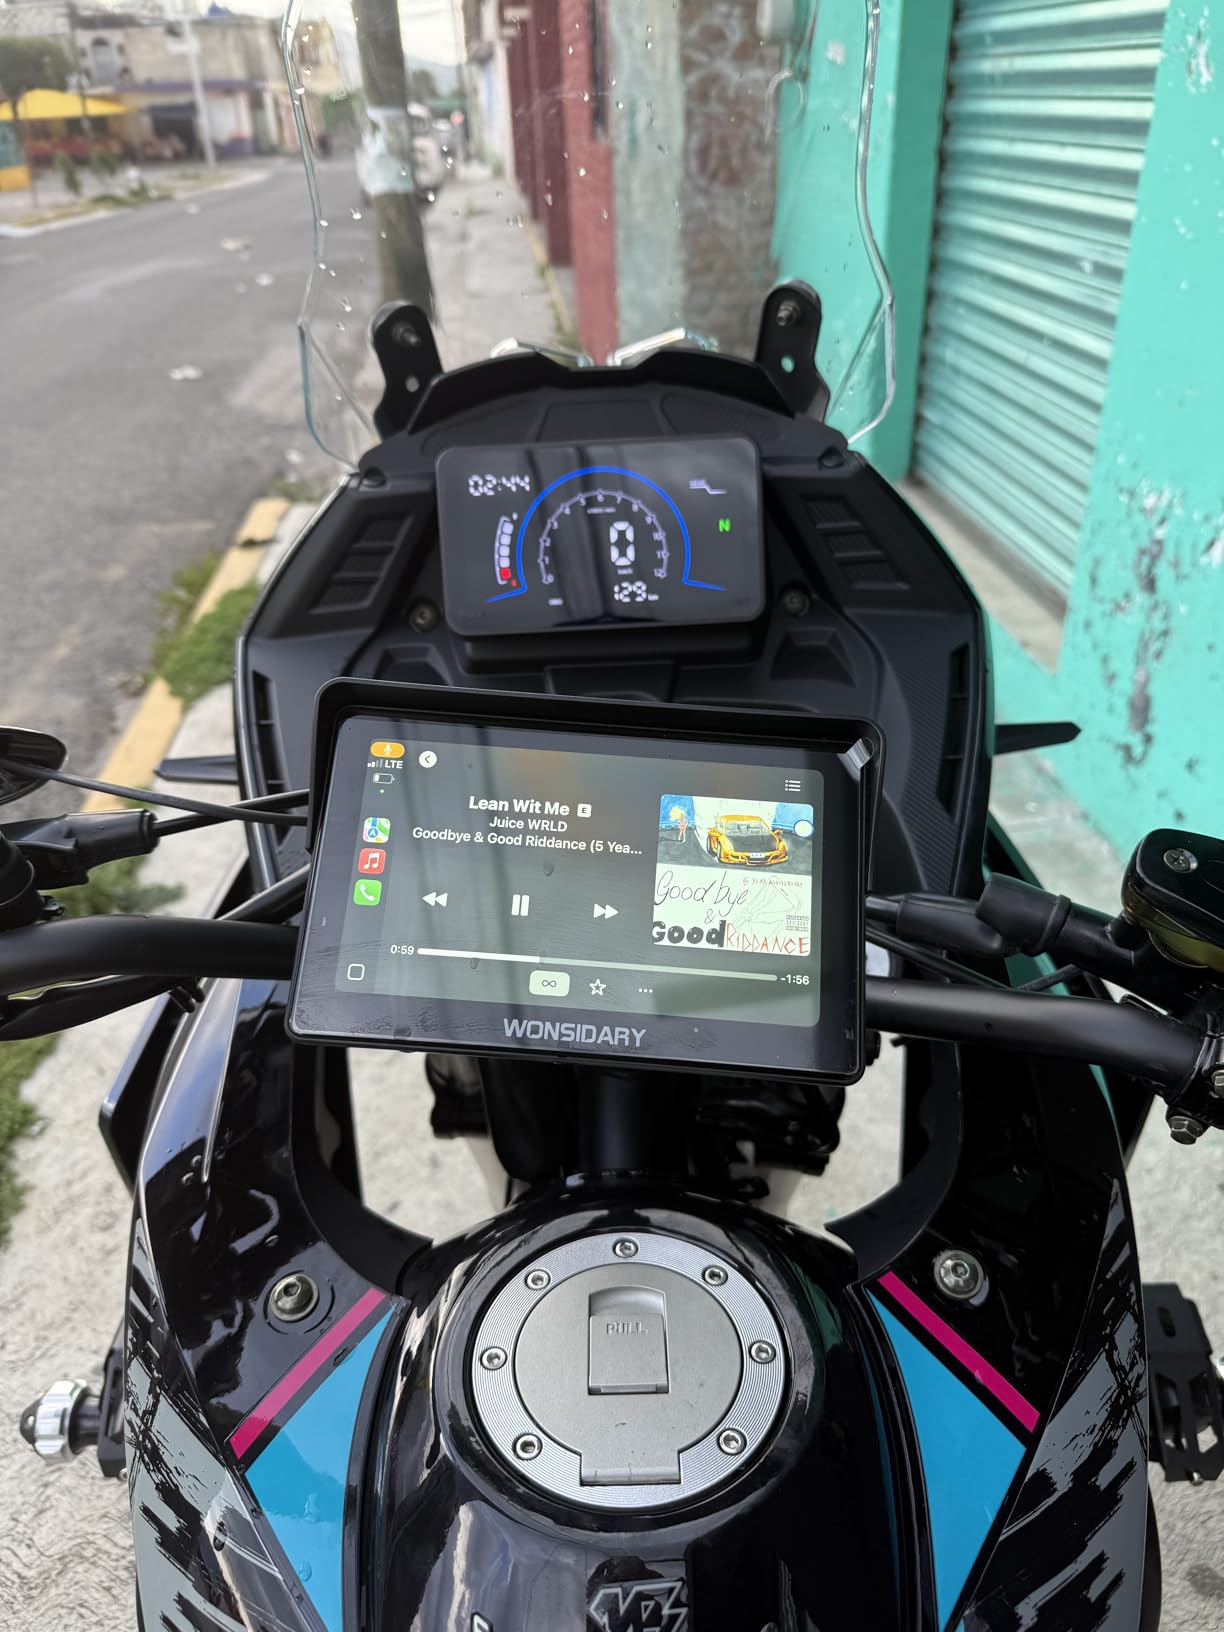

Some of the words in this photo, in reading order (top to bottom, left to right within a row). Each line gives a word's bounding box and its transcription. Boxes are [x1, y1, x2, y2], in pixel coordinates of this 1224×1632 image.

[468, 473, 530, 496] 02:44
[719, 518, 731, 533] N
[609, 520, 636, 567] 0
[613, 580, 647, 602] 129
[384, 760, 403, 769] LTE
[469, 796, 509, 812] Lean
[512, 799, 541, 814] Wit
[544, 801, 570, 816] Me
[489, 816, 525, 829] Juice
[527, 818, 568, 832] WRLD
[412, 827, 471, 843] Goodbye
[474, 831, 485, 843] &
[487, 832, 522, 847] Good
[525, 835, 587, 851] Riddance
[590, 839, 604, 853] (5
[606, 841, 643, 856] Yea...
[390, 944, 414, 956] 0:59
[780, 974, 810, 986] -1:56
[503, 1018, 647, 1048] WONSIDARY
[606, 1320, 649, 1336] PULL
